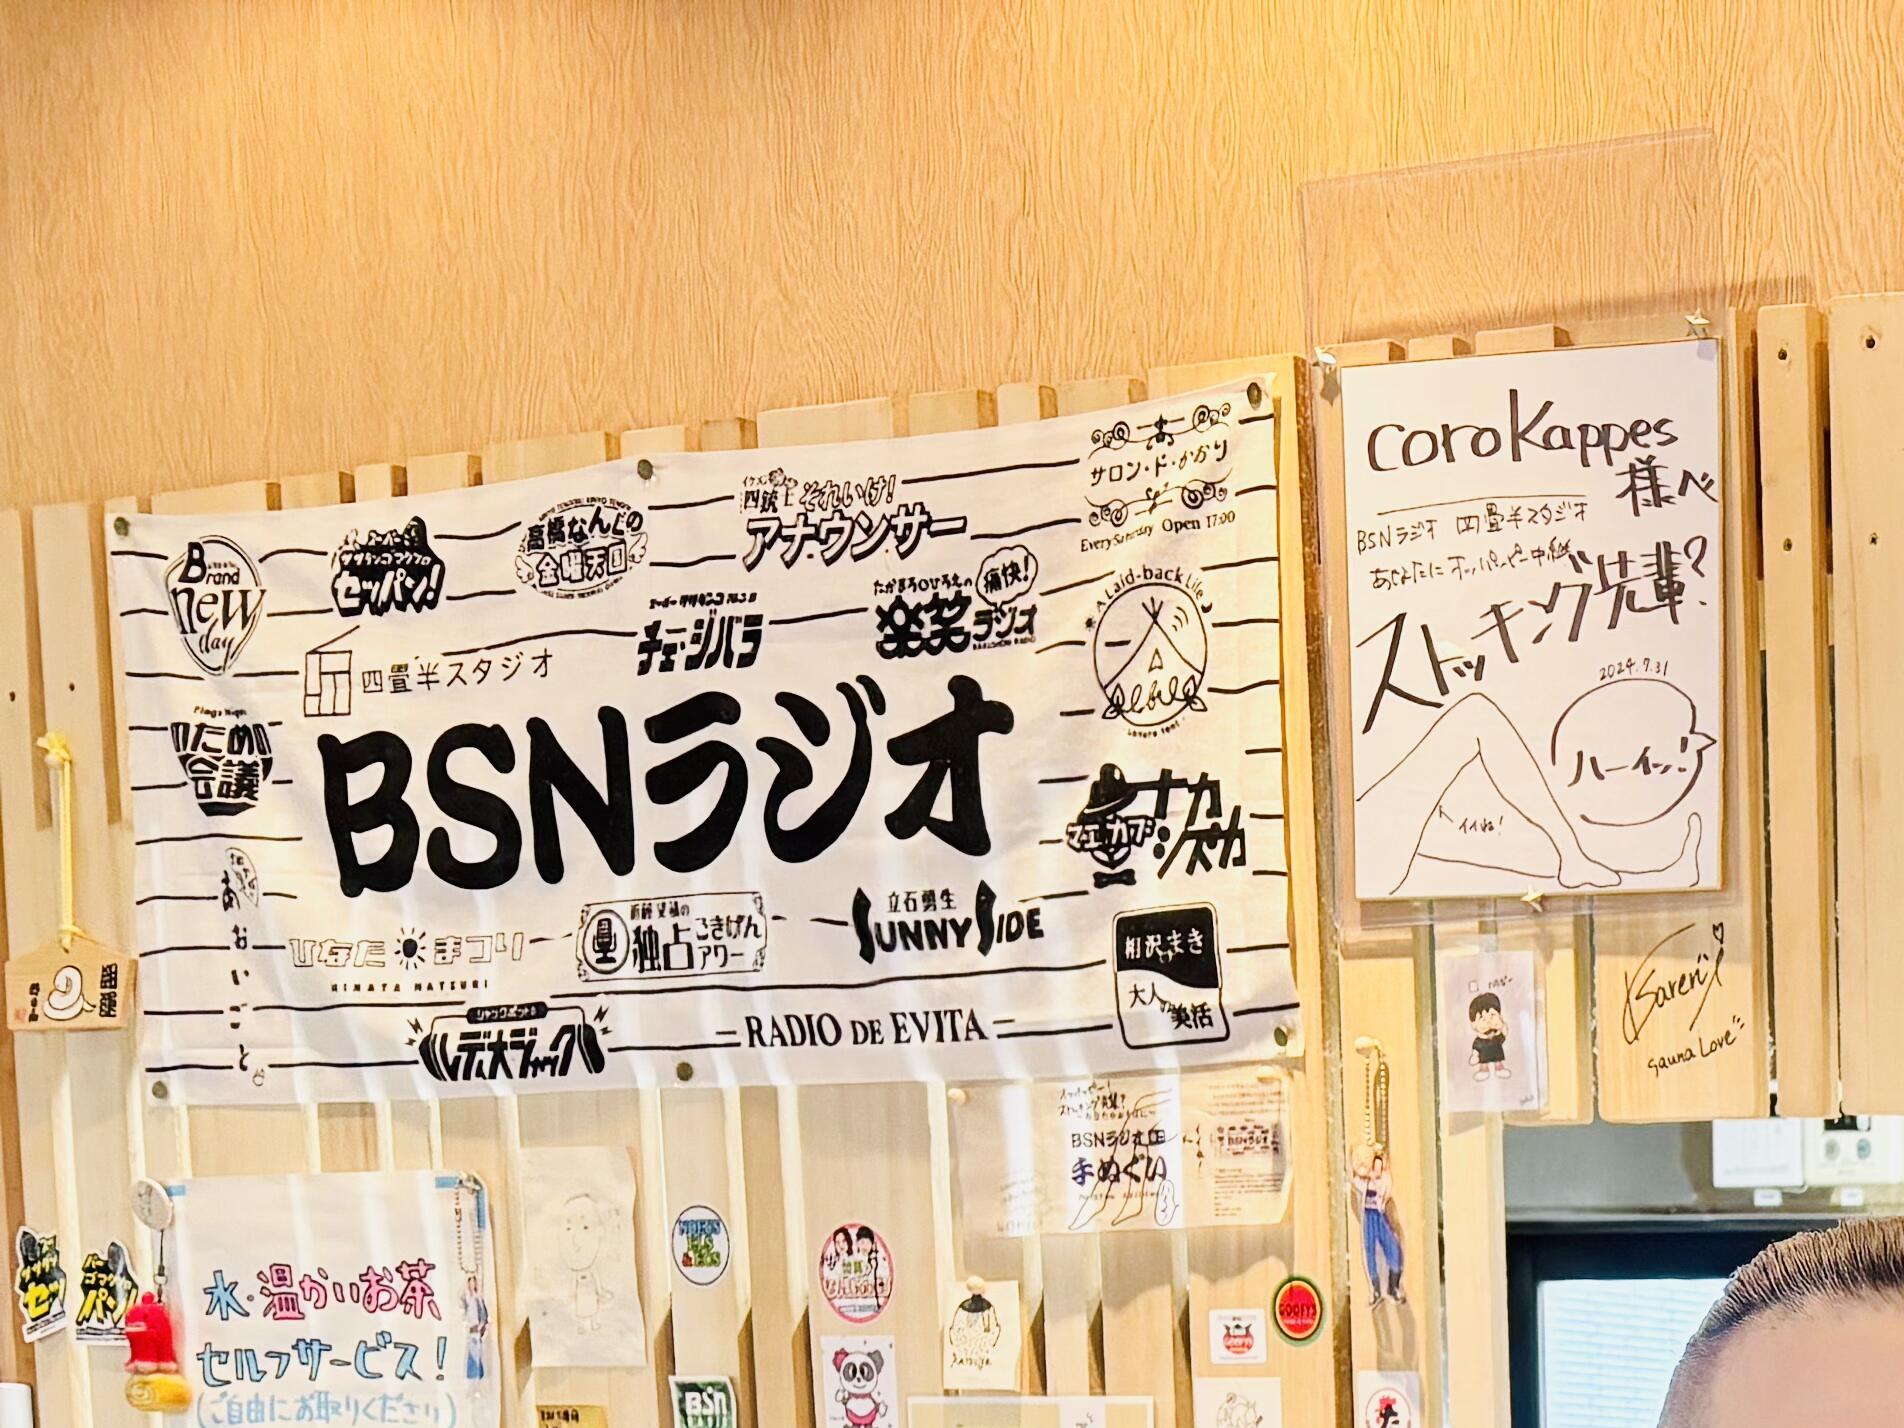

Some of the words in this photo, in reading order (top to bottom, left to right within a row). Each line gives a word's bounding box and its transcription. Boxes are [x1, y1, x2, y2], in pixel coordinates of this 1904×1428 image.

[800, 474, 896, 512] それいけ!
[742, 502, 968, 572] アナウンサー
[1081, 533, 1113, 553] Every
[1161, 518, 1201, 534] Open
[1206, 511, 1236, 530] 17:00
[1356, 519, 1438, 554] BSNラジオ
[1456, 502, 1589, 535] 四畳半スタジオ
[178, 541, 240, 584] Brand
[983, 557, 1030, 594] 痛快!
[1105, 566, 1184, 600] Laid-back
[1185, 573, 1204, 599] Life
[170, 587, 266, 635] new
[972, 603, 1038, 643] ラジオ
[198, 624, 236, 668] day
[1356, 535, 1708, 734] ストッキング先輩?
[362, 648, 553, 694] 四畳半スタジオ
[1600, 657, 1669, 681] 2024.7.31
[317, 673, 1014, 897] BSNラジオ
[632, 922, 694, 972] 独占
[696, 913, 762, 941] ごきげん
[852, 888, 972, 964] SUNNY
[976, 880, 1044, 956] SIDE
[289, 938, 386, 968] ひなた
[433, 931, 524, 966] まつり
[700, 946, 744, 970] アワー
[747, 1012, 843, 1049] RADIO
[851, 1019, 885, 1045] DE
[892, 1008, 989, 1044] EVITA
[204, 1258, 443, 1322] 水・温かいお茶
[196, 1331, 449, 1388] セルフサービス!
[685, 1387, 728, 1415] BSN
